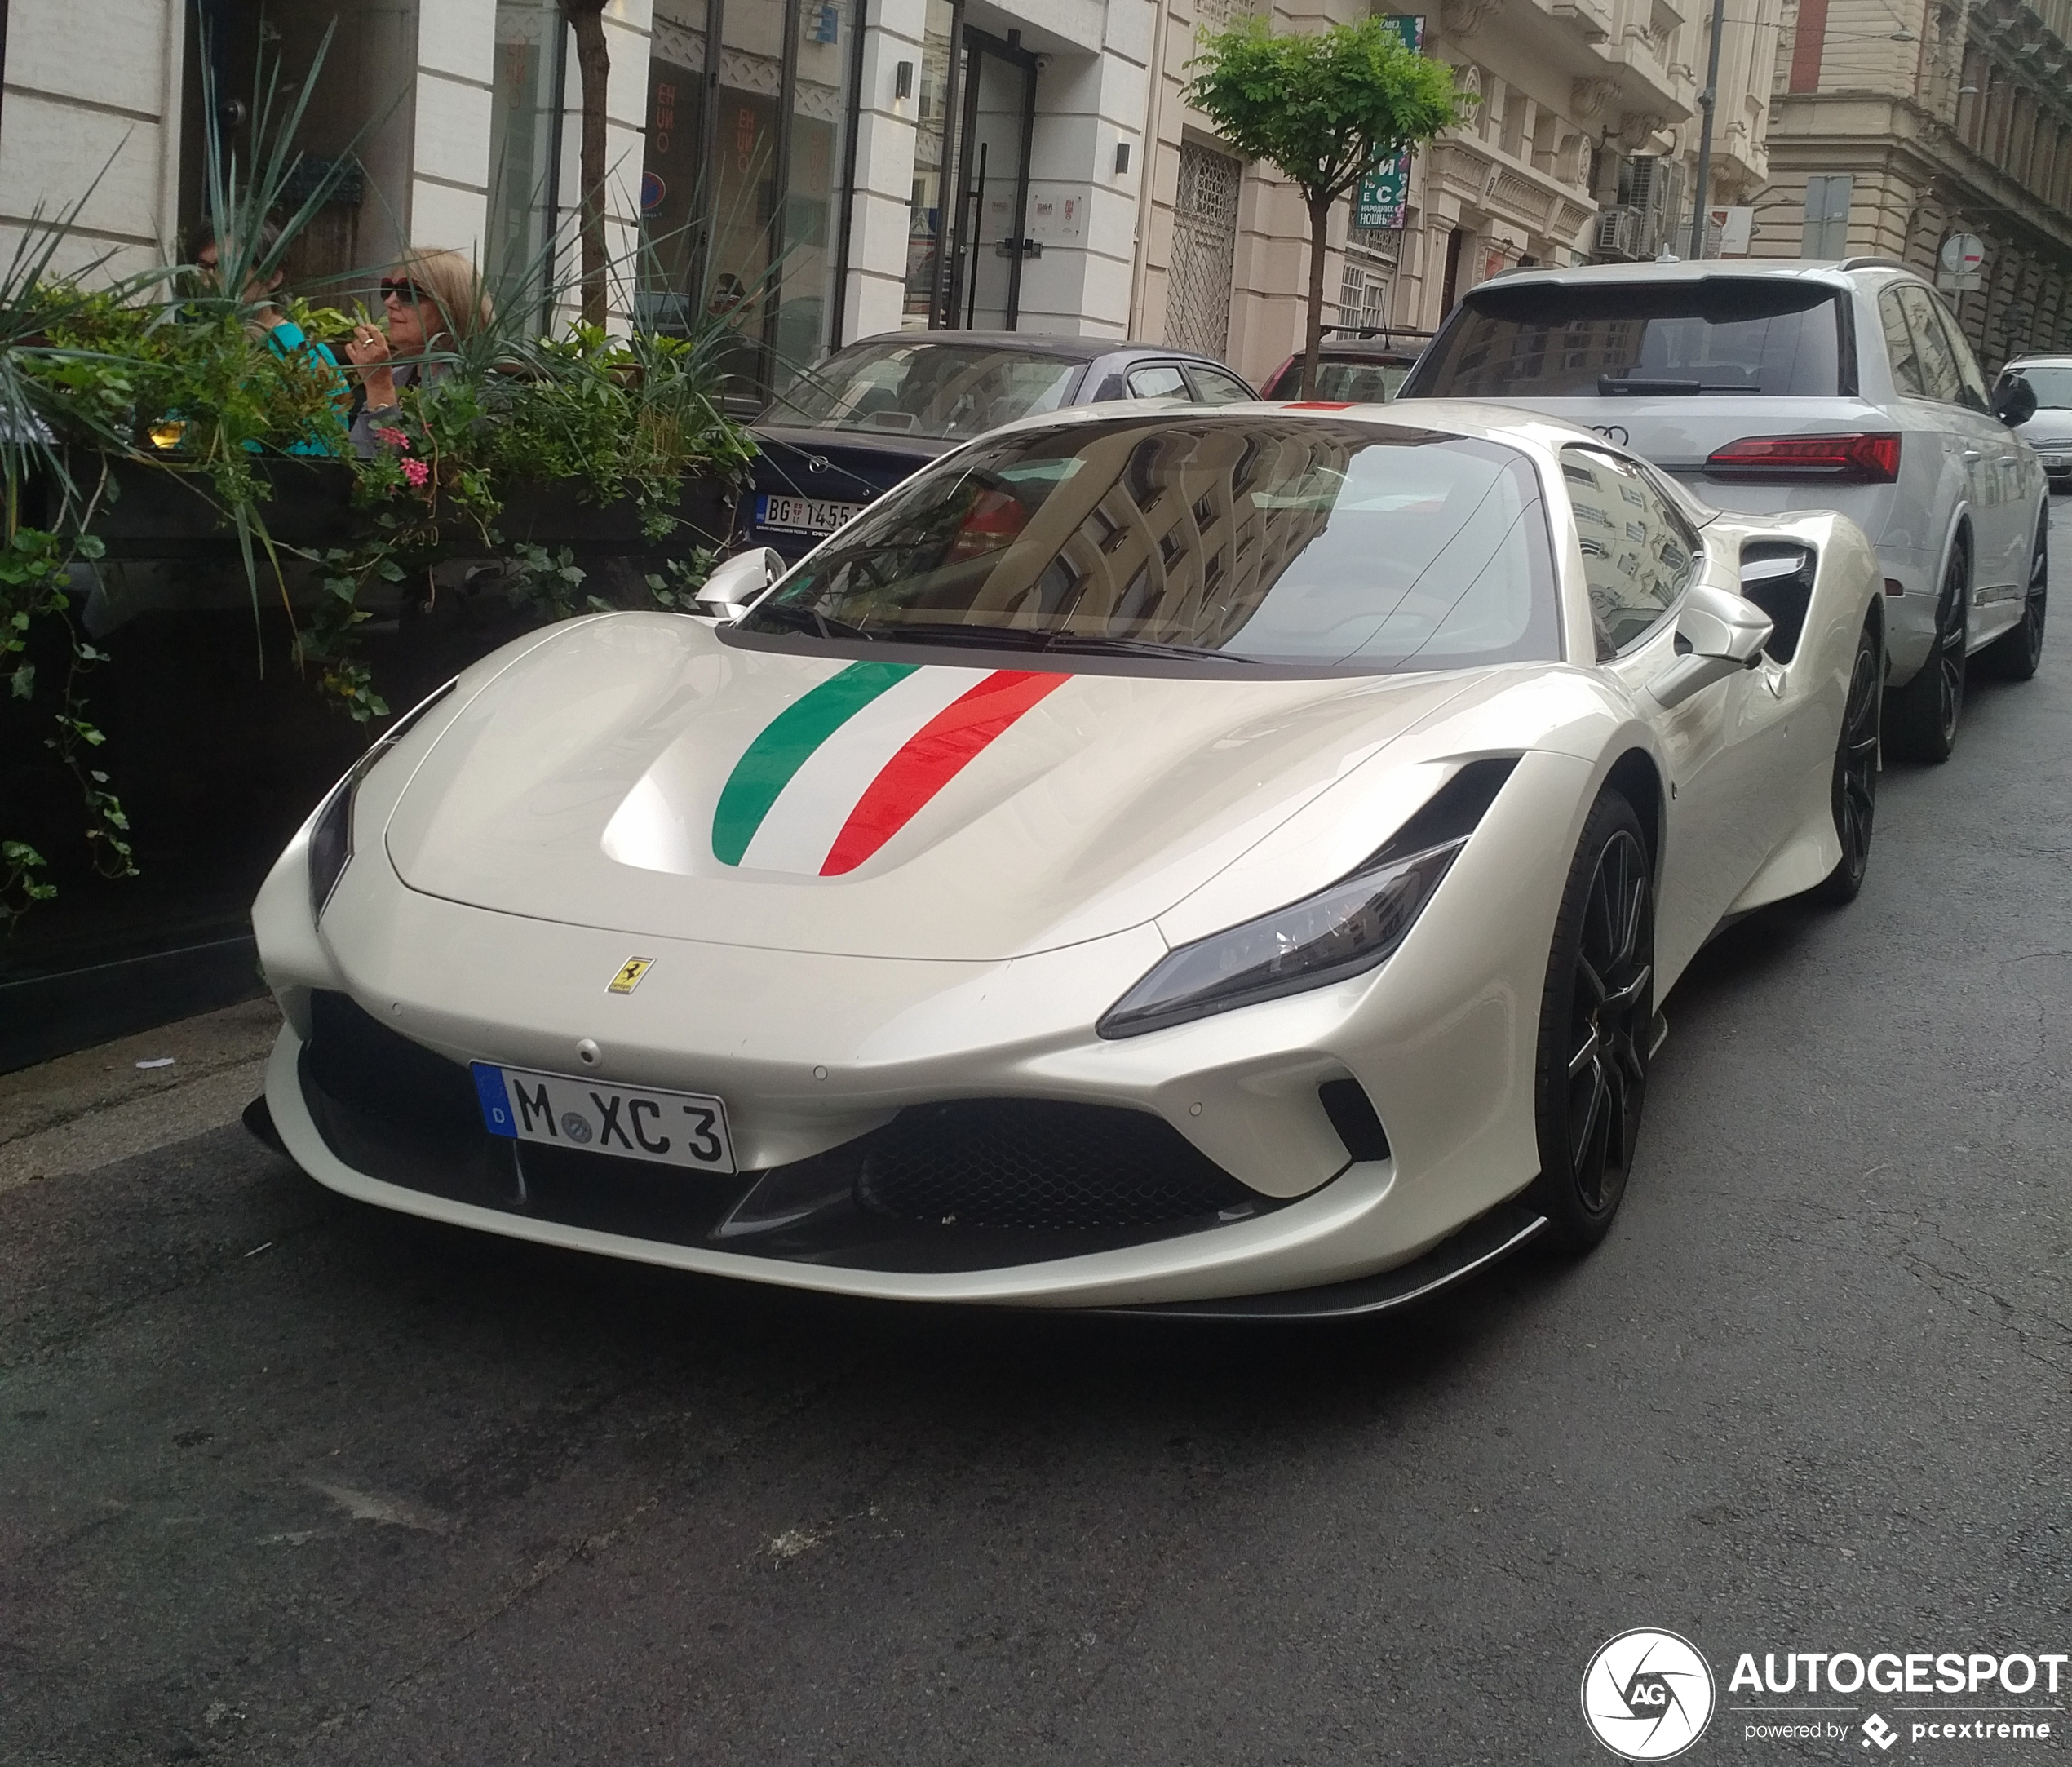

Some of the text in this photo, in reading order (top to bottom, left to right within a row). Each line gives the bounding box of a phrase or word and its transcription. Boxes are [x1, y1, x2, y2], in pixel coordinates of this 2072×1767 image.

[1361, 204, 1394, 214] НАРОДНИХ
[1360, 213, 1393, 225] НОШЊ
[768, 498, 790, 522] BG
[493, 1108, 505, 1123] D
[512, 1078, 722, 1162] M XC 3
